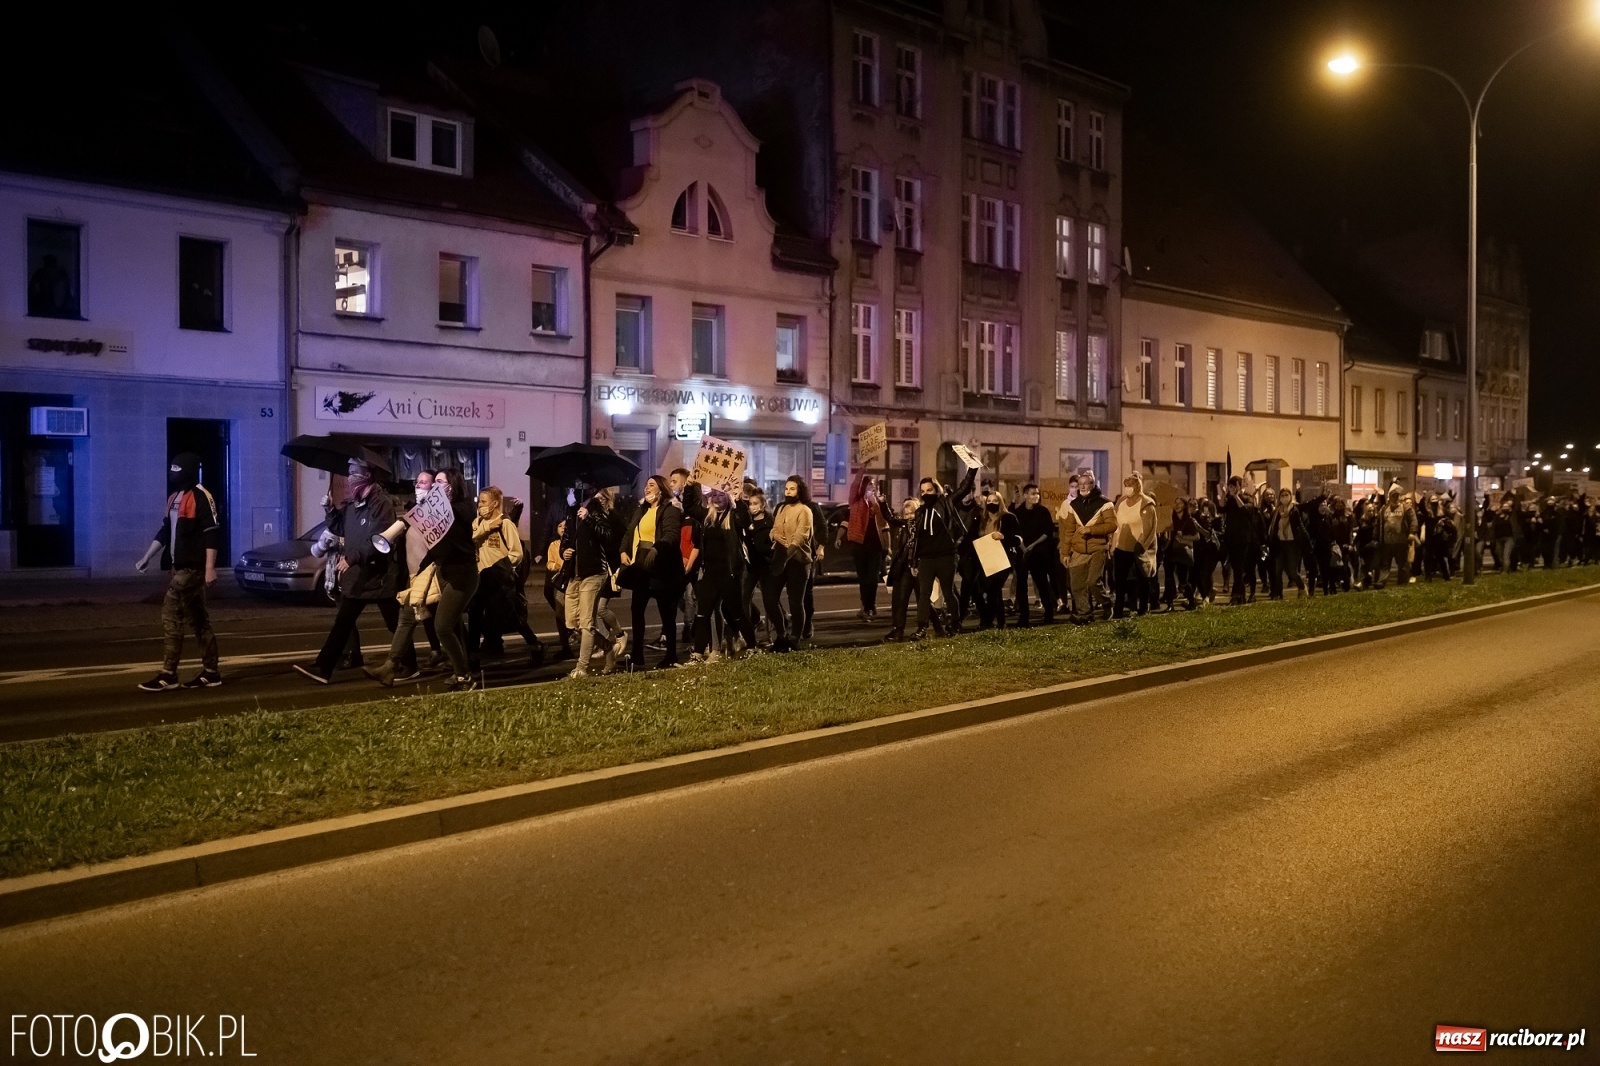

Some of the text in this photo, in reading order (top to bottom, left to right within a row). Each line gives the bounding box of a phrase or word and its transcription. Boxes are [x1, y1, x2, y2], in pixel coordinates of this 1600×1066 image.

[260, 408, 274, 418] 53
[377, 398, 495, 421] Ani Ciuszek 3
[595, 429, 607, 440] 51
[409, 486, 443, 522] TO JEST
[440, 501, 447, 514] Z
